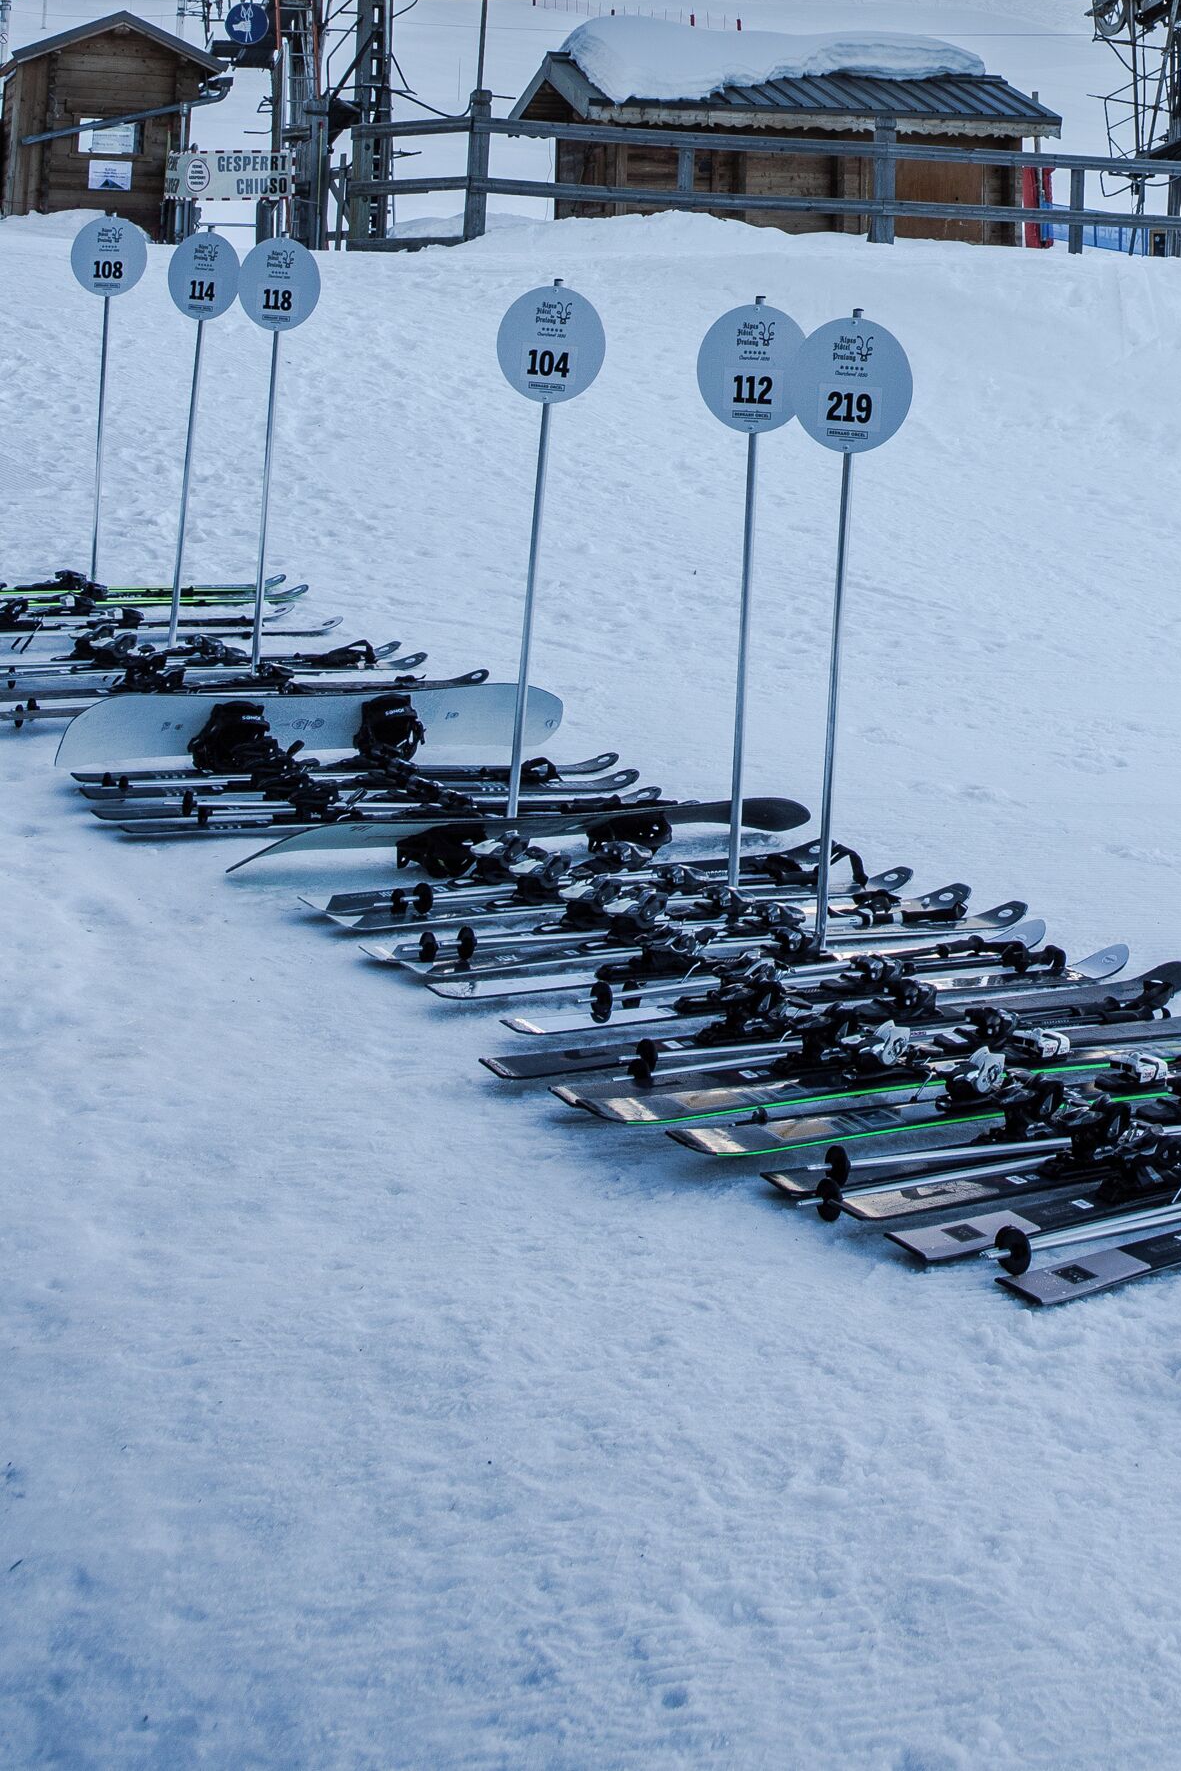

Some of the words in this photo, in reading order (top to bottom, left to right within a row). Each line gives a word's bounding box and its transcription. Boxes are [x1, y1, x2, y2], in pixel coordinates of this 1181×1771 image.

[217, 155, 288, 172] GESPERRT
[236, 177, 288, 195] CHIUSO
[93, 260, 123, 279] 108
[189, 280, 215, 302] 114
[262, 288, 292, 311] 118
[527, 349, 570, 378] 104
[733, 374, 773, 405] 112
[825, 391, 873, 424] 219
